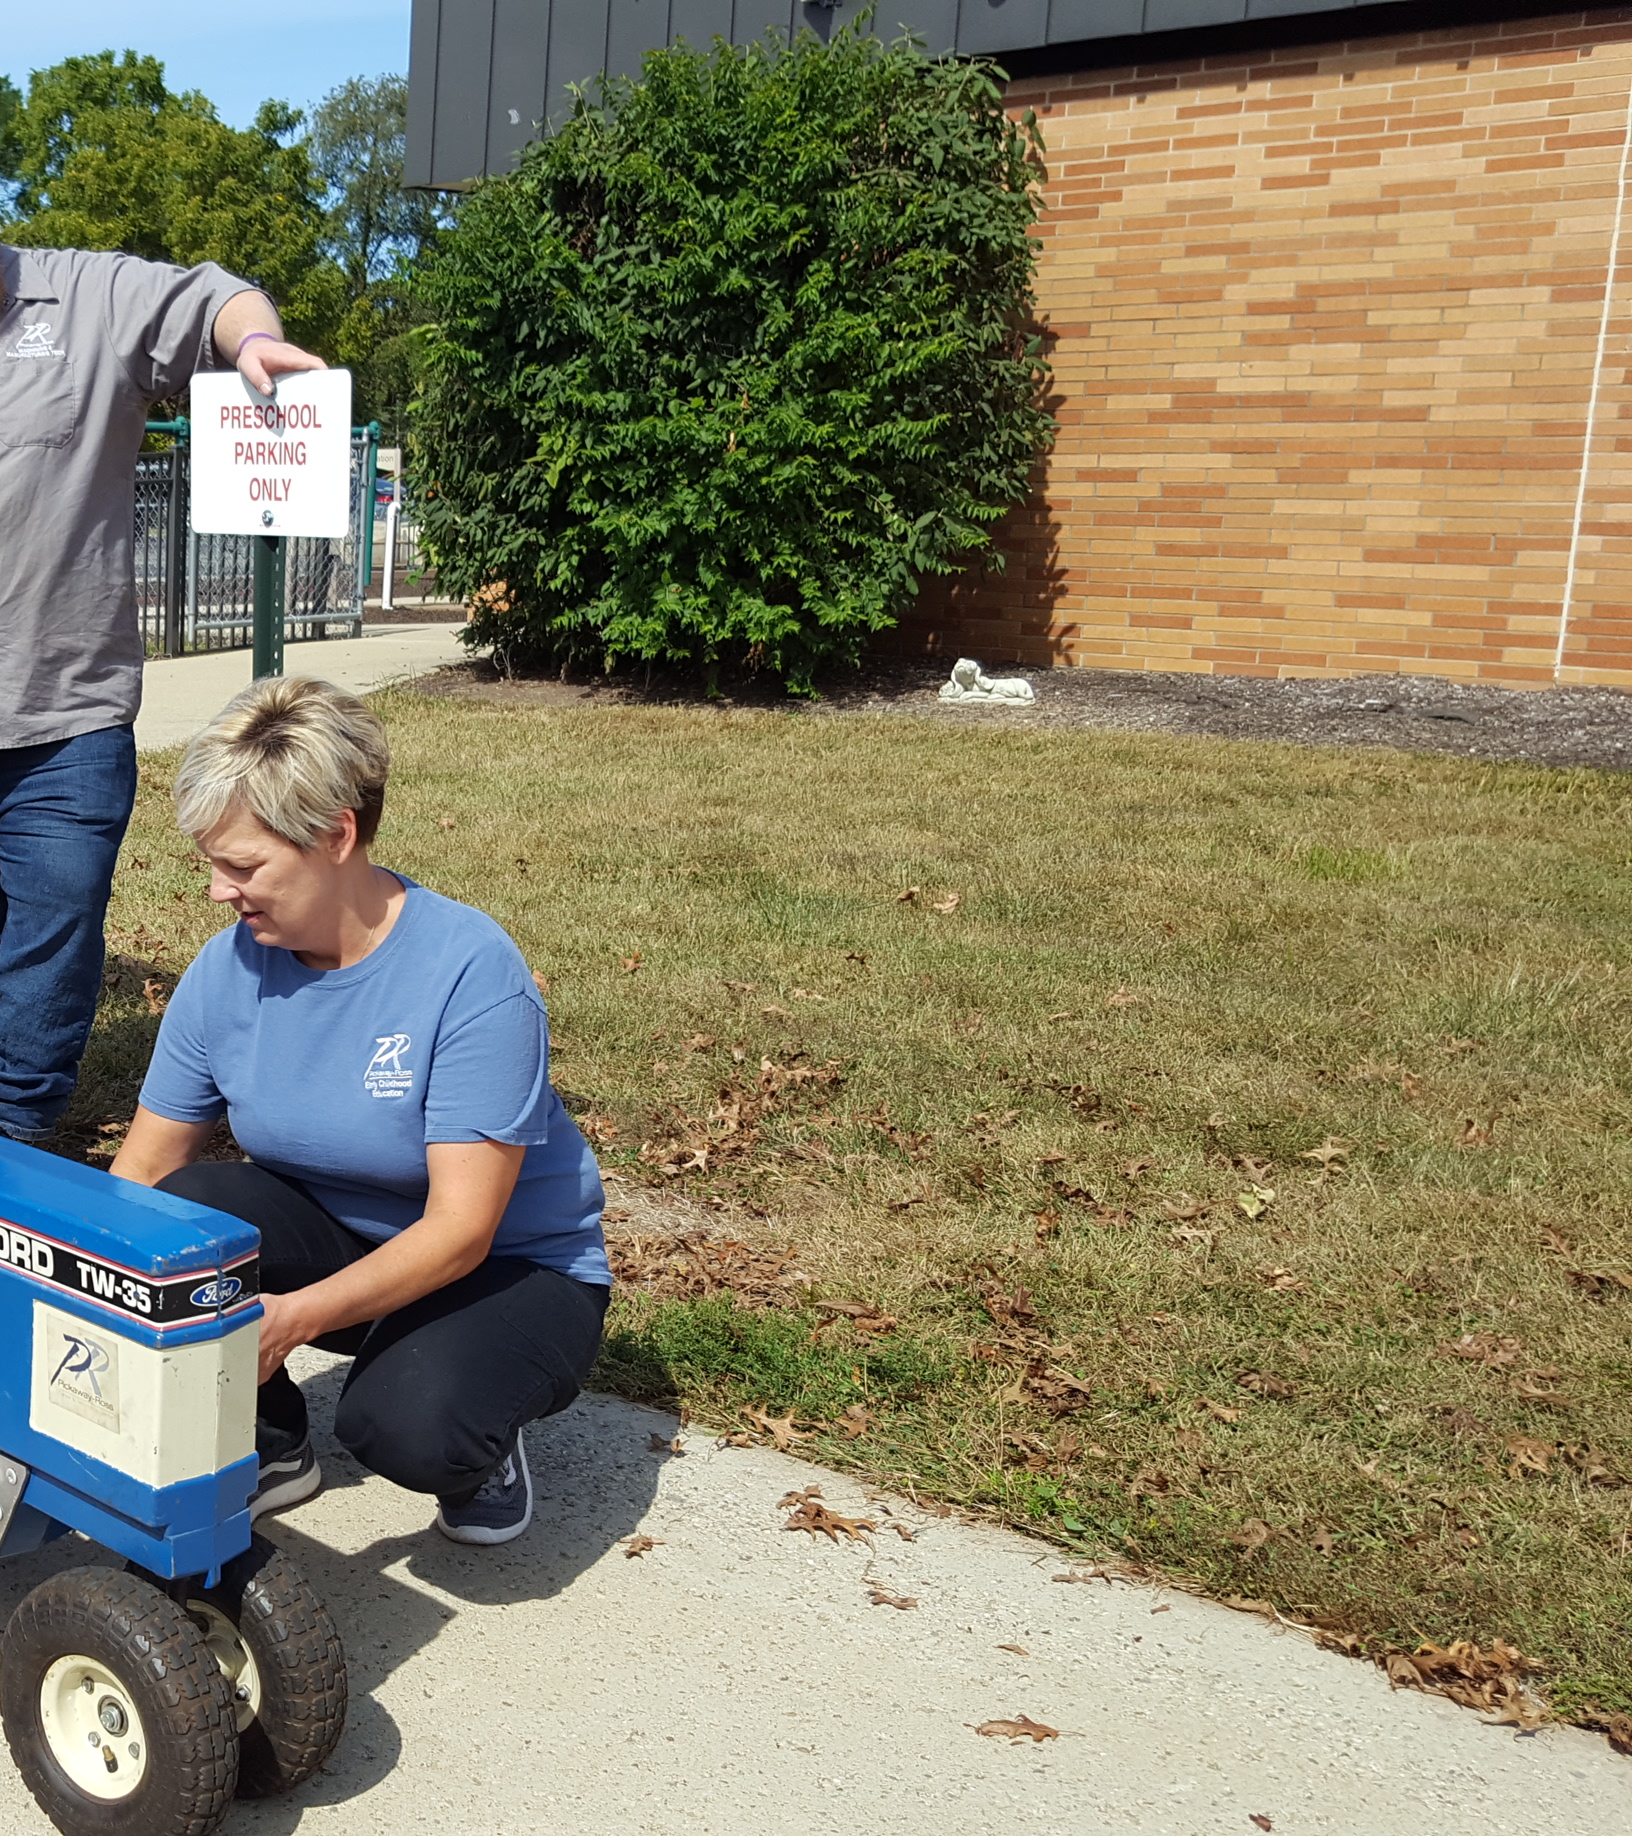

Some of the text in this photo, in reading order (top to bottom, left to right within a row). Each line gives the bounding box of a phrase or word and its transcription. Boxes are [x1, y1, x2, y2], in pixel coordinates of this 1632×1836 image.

[220, 404, 322, 429] PRESCHOOL
[234, 441, 307, 466] PARKING
[249, 477, 292, 502] ONLY
[76, 1260, 151, 1314] TW-35
[201, 1282, 234, 1303] Ford
[57, 1378, 114, 1412] Pickaway-Ross
